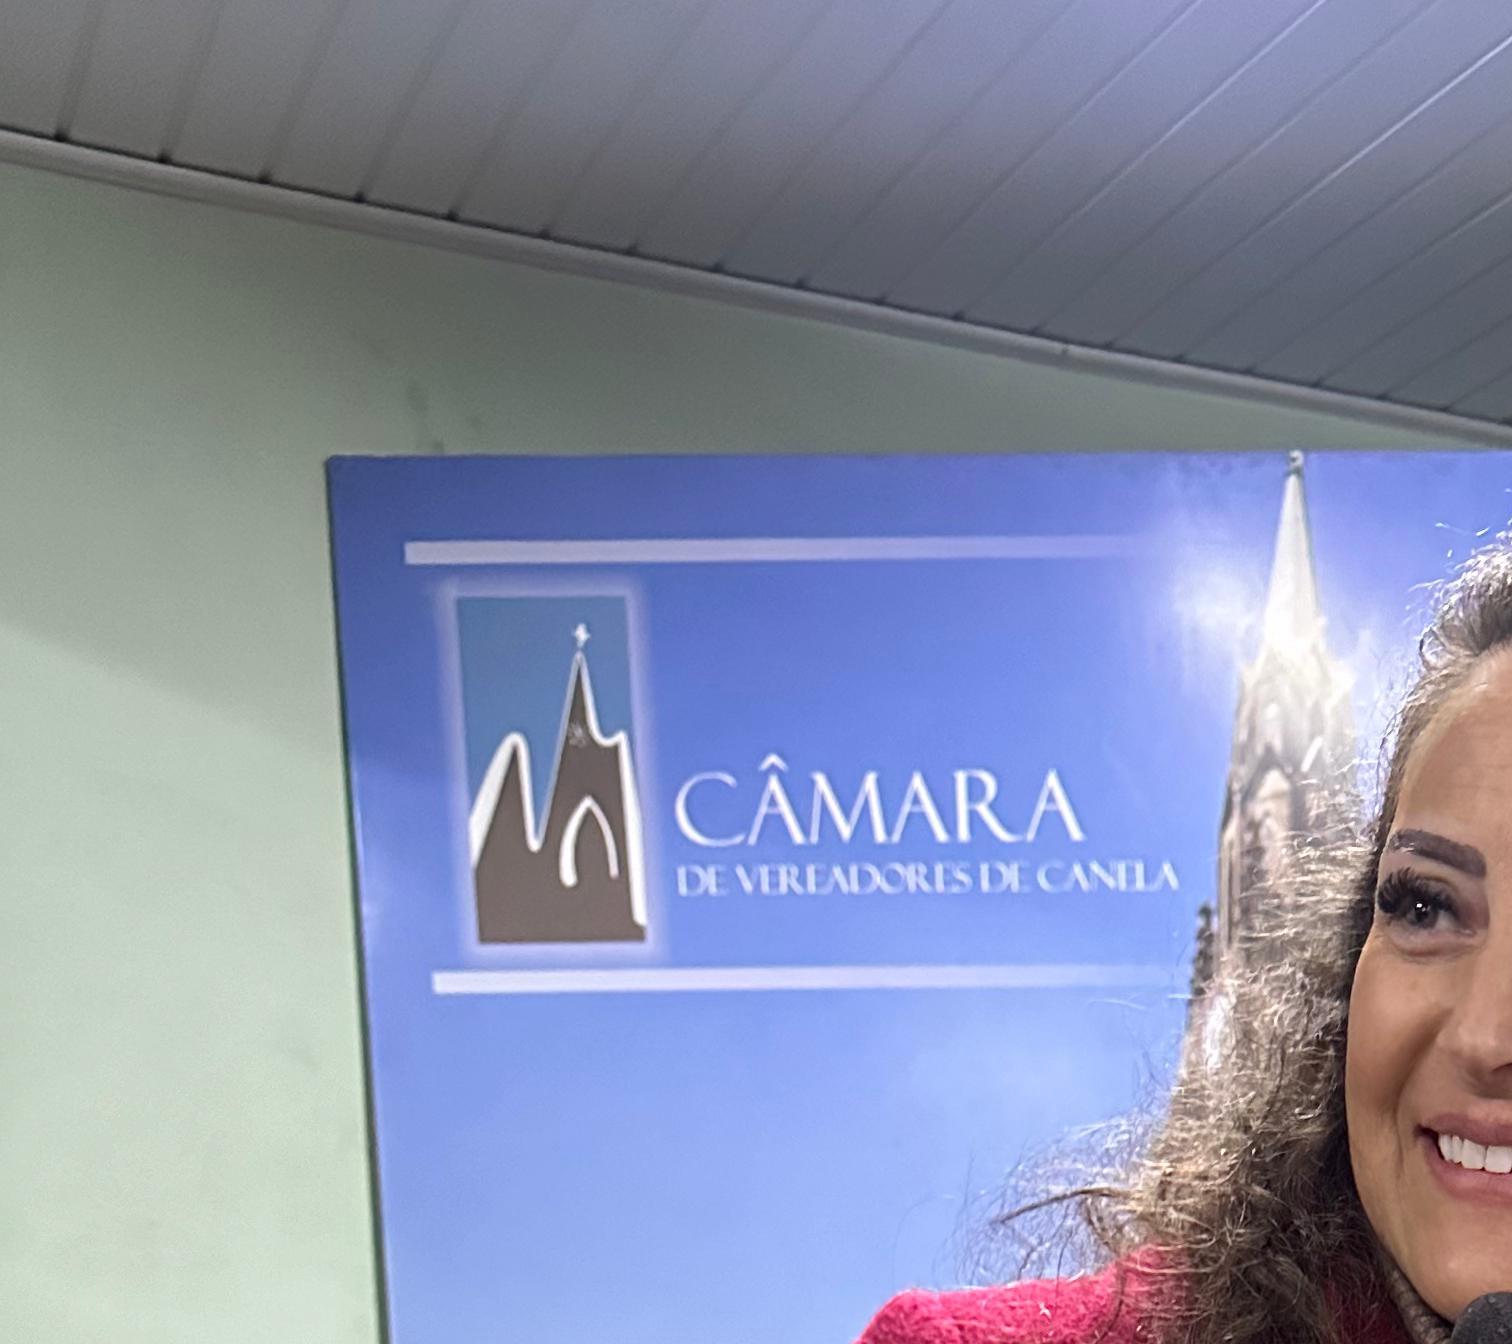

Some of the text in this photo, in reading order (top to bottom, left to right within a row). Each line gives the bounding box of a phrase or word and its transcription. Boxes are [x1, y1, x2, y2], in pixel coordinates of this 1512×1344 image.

[675, 752, 1087, 848] CÂMARA
[676, 859, 1181, 897] DE VEREADORES DE CANELA
